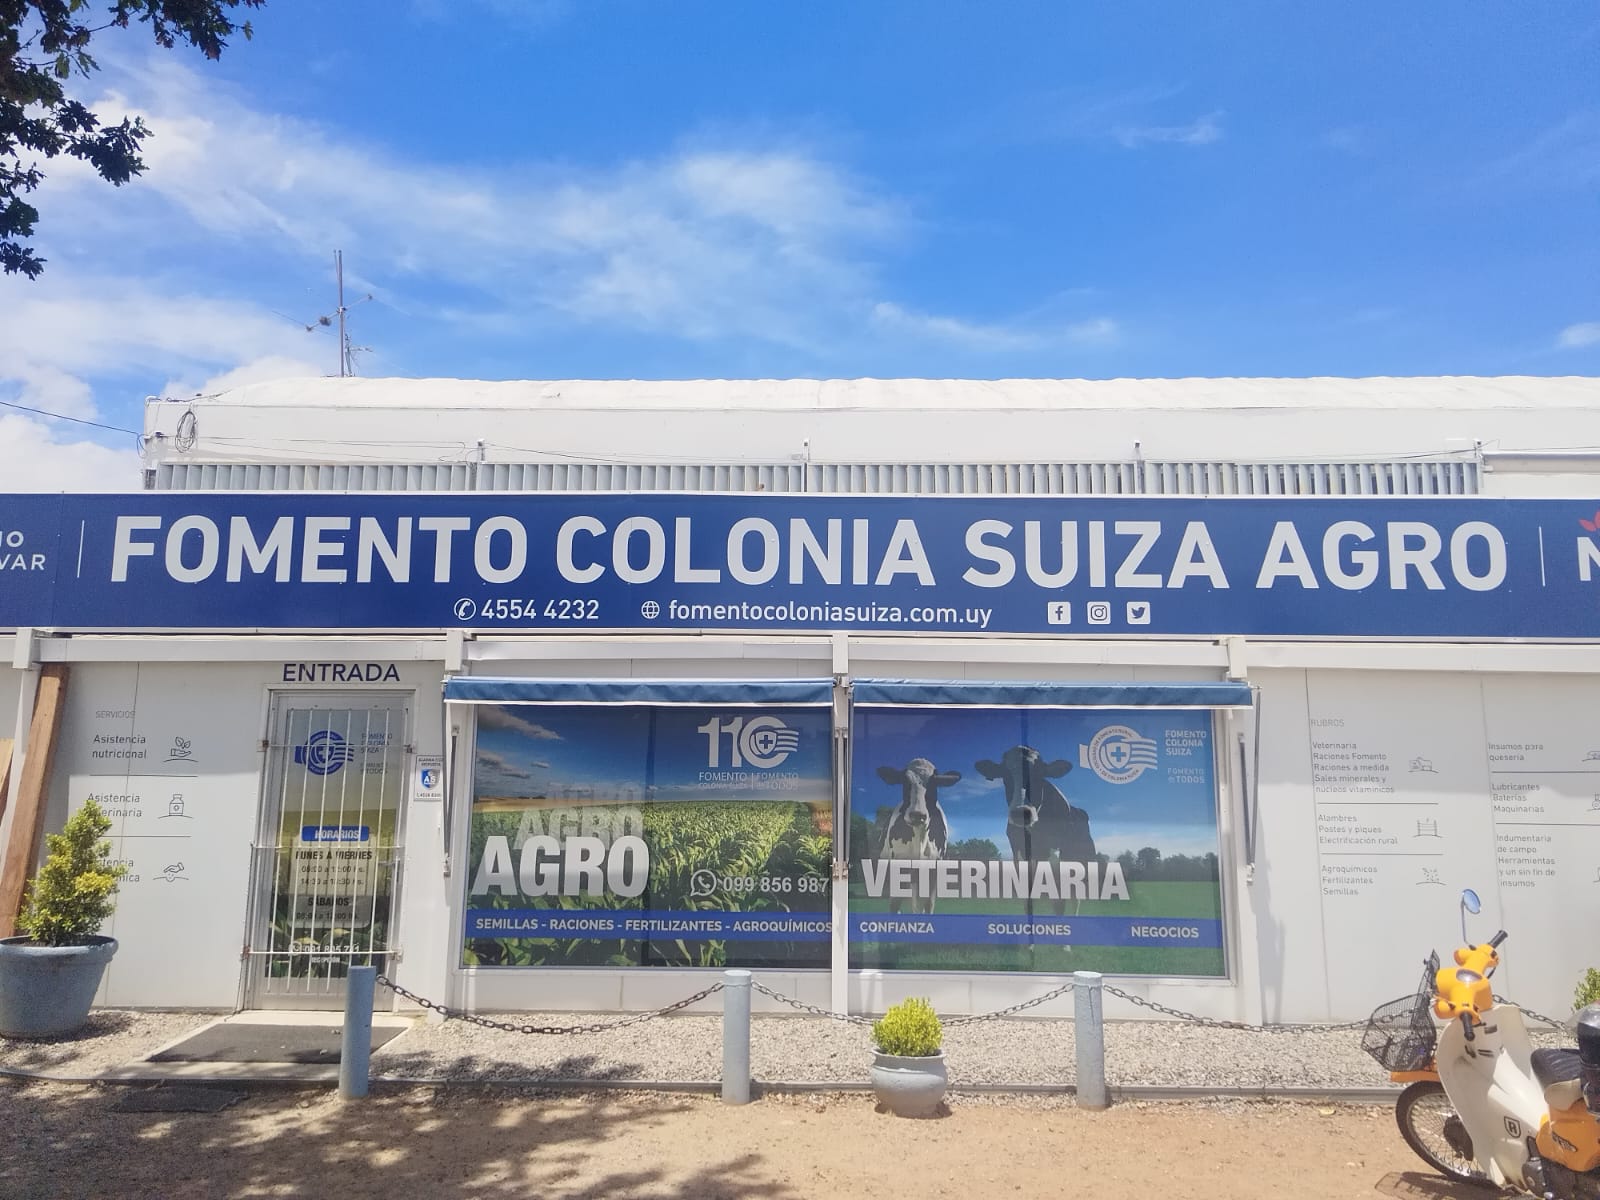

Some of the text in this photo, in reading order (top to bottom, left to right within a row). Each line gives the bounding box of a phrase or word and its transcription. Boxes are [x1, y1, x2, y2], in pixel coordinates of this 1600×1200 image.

[0, 531, 24, 547] O
[111, 515, 1507, 591] FOMENTO COLONIA SUIZA AGRO
[481, 599, 600, 620] 4554 4232
[669, 600, 992, 628] fomentocoloniasuiza.com.uy
[283, 663, 400, 682] ENTRADA
[95, 710, 136, 719] SERVICIOS
[93, 734, 146, 744] Asistencia
[1165, 729, 1207, 738] FOMENTO
[1165, 739, 1203, 747] COLONIA
[1312, 742, 1357, 750] Veterinaria
[92, 749, 147, 759] nutricional
[1165, 748, 1192, 756] SUIZA
[1314, 763, 1351, 771] Raciones
[1360, 763, 1390, 771] medida
[699, 772, 747, 782] FOMENTO
[1315, 774, 1337, 782] Sales
[1340, 774, 1379, 782] minerales
[1491, 783, 1540, 791] Lubricantes
[87, 792, 140, 803] Asistencia
[97, 807, 142, 817] erinaria
[470, 835, 649, 897] AGRO
[722, 877, 829, 893] 099 856 987
[861, 859, 1130, 901] VETERINARIA
[476, 918, 538, 930] SEMILLAS
[550, 918, 614, 931] RACIONES
[625, 919, 722, 932] FERTILIZANTES
[733, 918, 832, 933] AGROQUÍMICOS
[859, 921, 935, 934] CONFIANZA
[988, 923, 1072, 936] SOLUCIONES
[1131, 926, 1199, 939] NEGOCIOS
